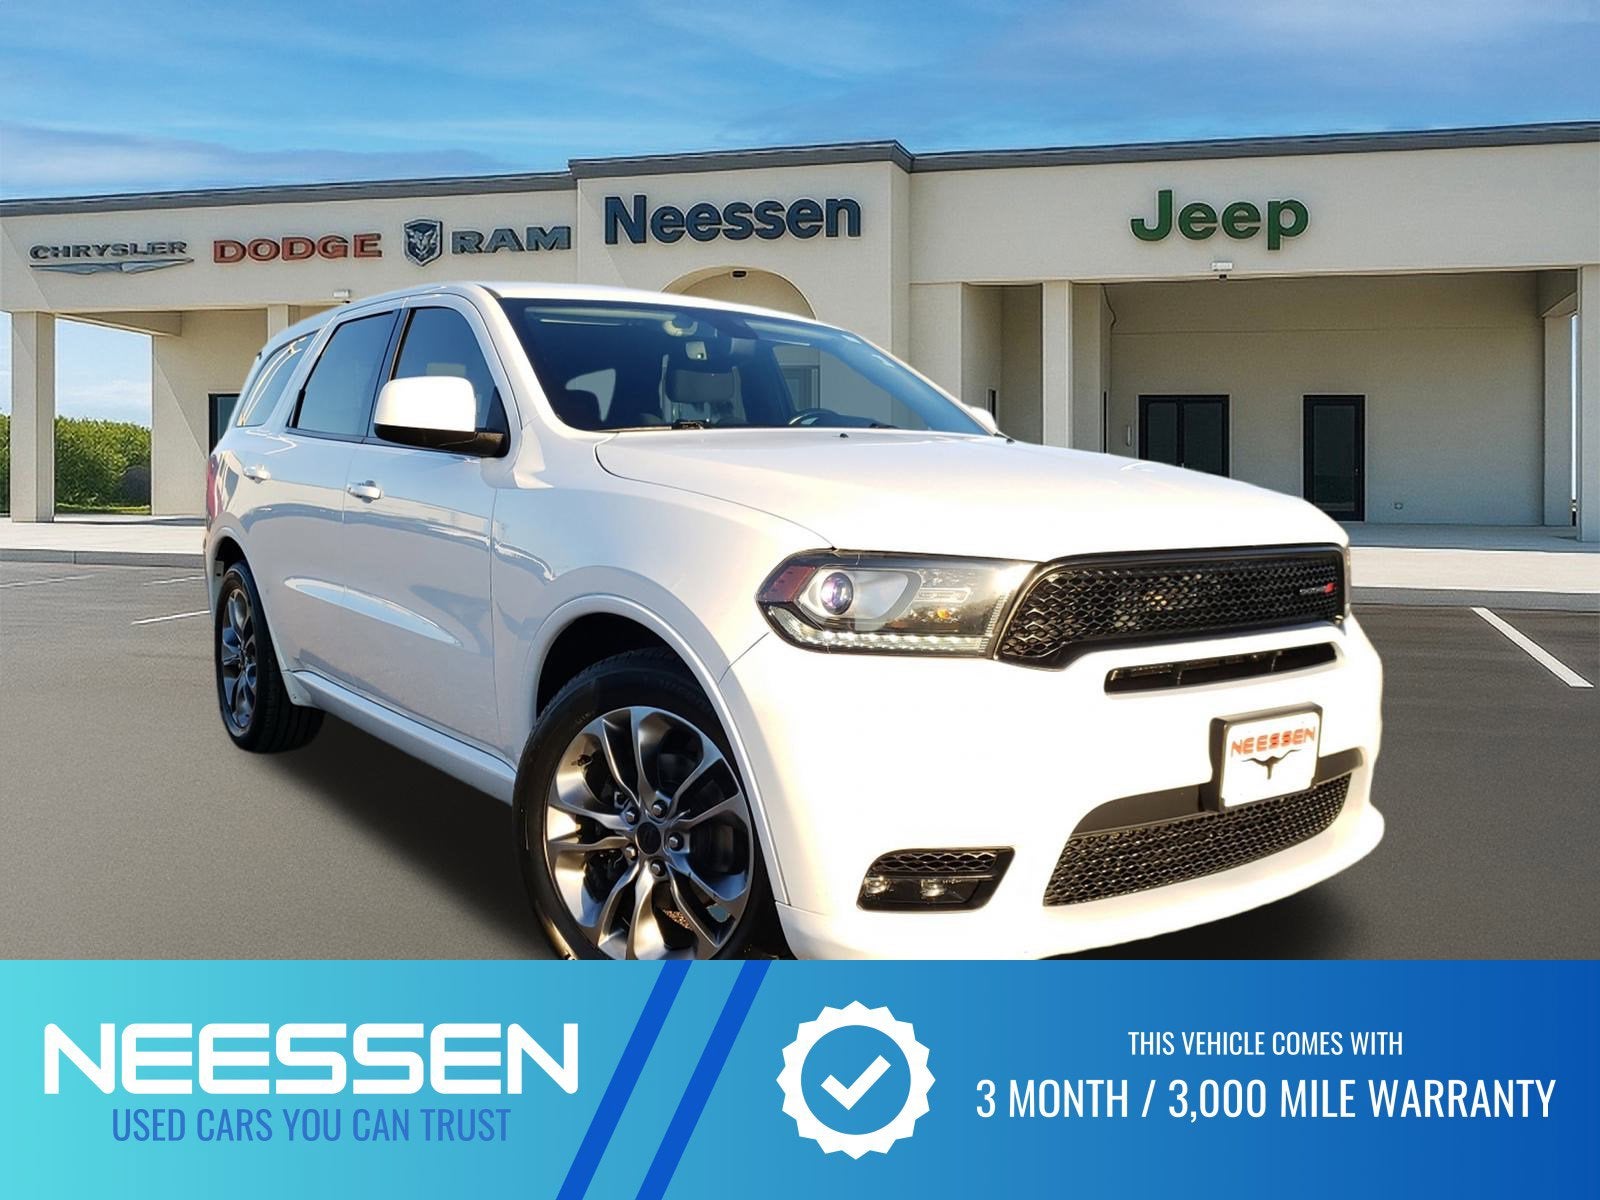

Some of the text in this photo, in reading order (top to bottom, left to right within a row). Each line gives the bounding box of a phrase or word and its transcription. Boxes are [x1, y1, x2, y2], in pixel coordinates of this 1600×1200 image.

[604, 194, 862, 245] Neessen
[1130, 189, 1310, 250] Jeep
[29, 240, 188, 259] CHRYSLER
[213, 233, 383, 264] DODGE
[451, 225, 572, 254] RAM
[1231, 727, 1315, 757] NEESSEN
